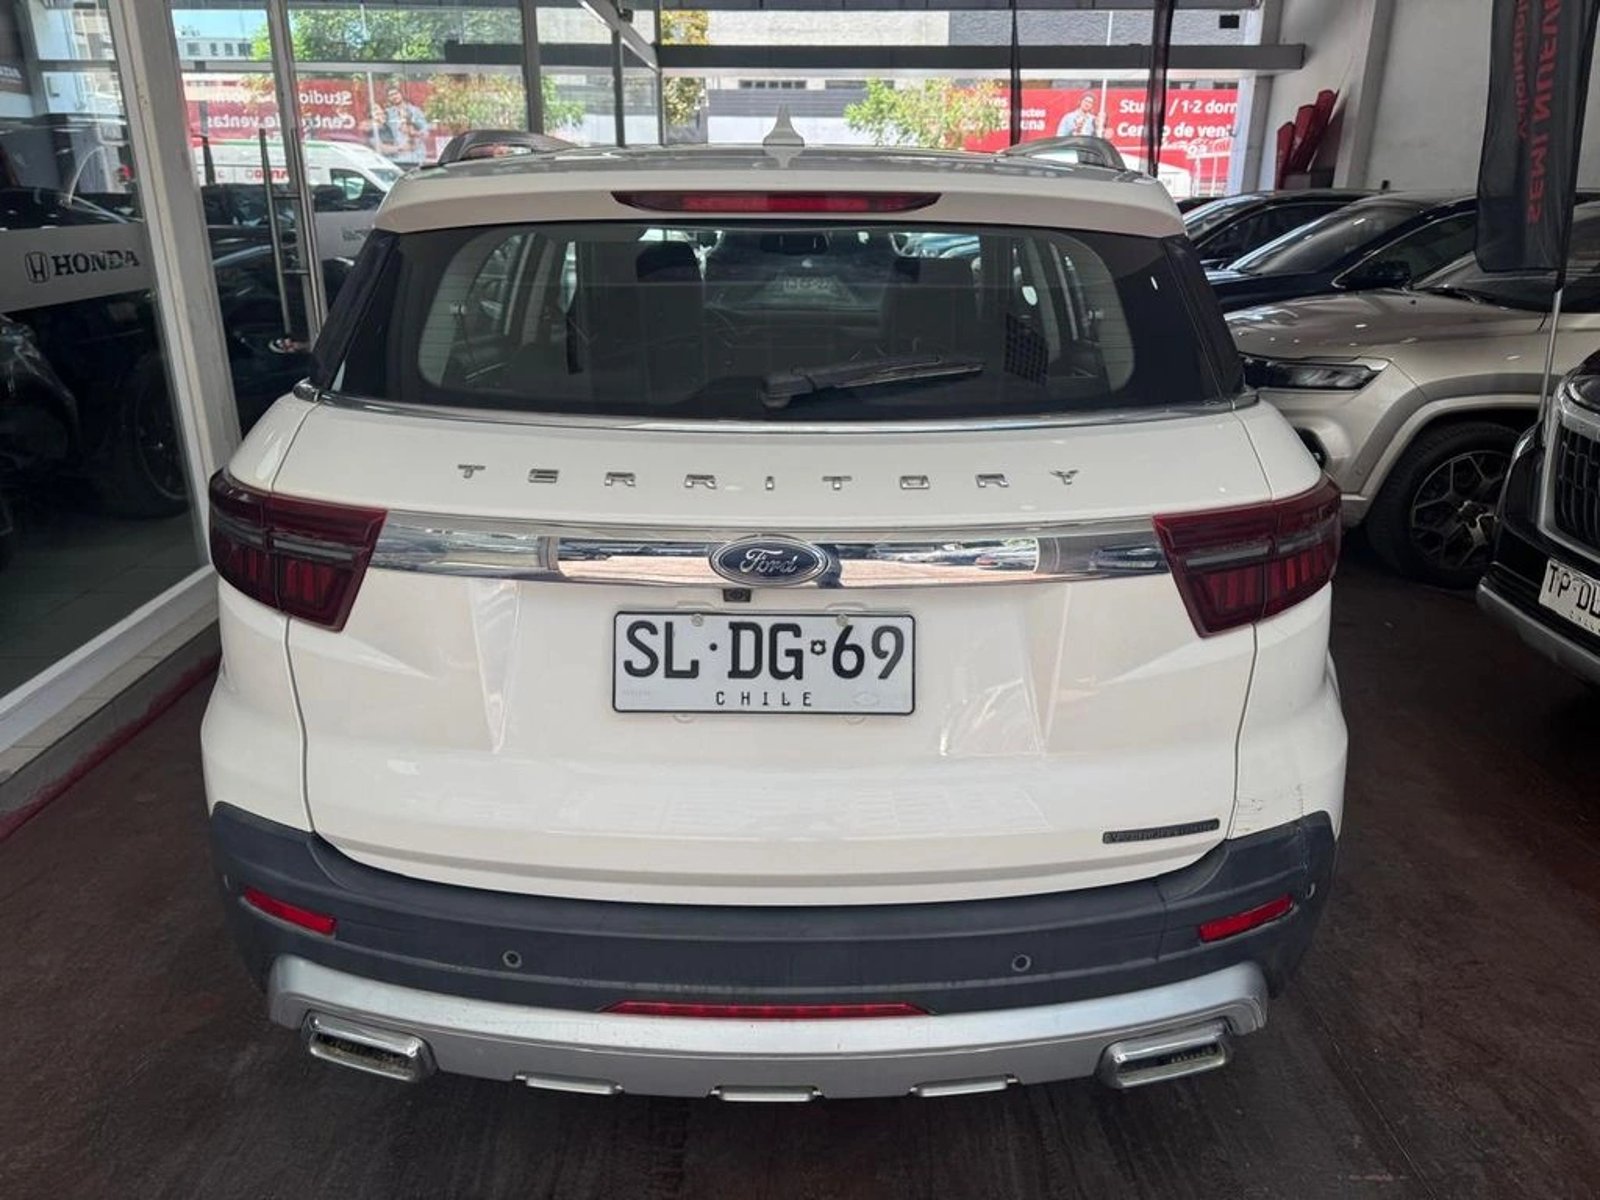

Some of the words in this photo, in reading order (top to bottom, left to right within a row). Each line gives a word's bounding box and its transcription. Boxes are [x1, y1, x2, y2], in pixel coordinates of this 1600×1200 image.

[1174, 122, 1194, 138] de
[51, 250, 139, 276] HONDA
[457, 464, 1079, 492] TERRITORY
[740, 548, 798, 574] Ford
[715, 690, 812, 707] CHILE
